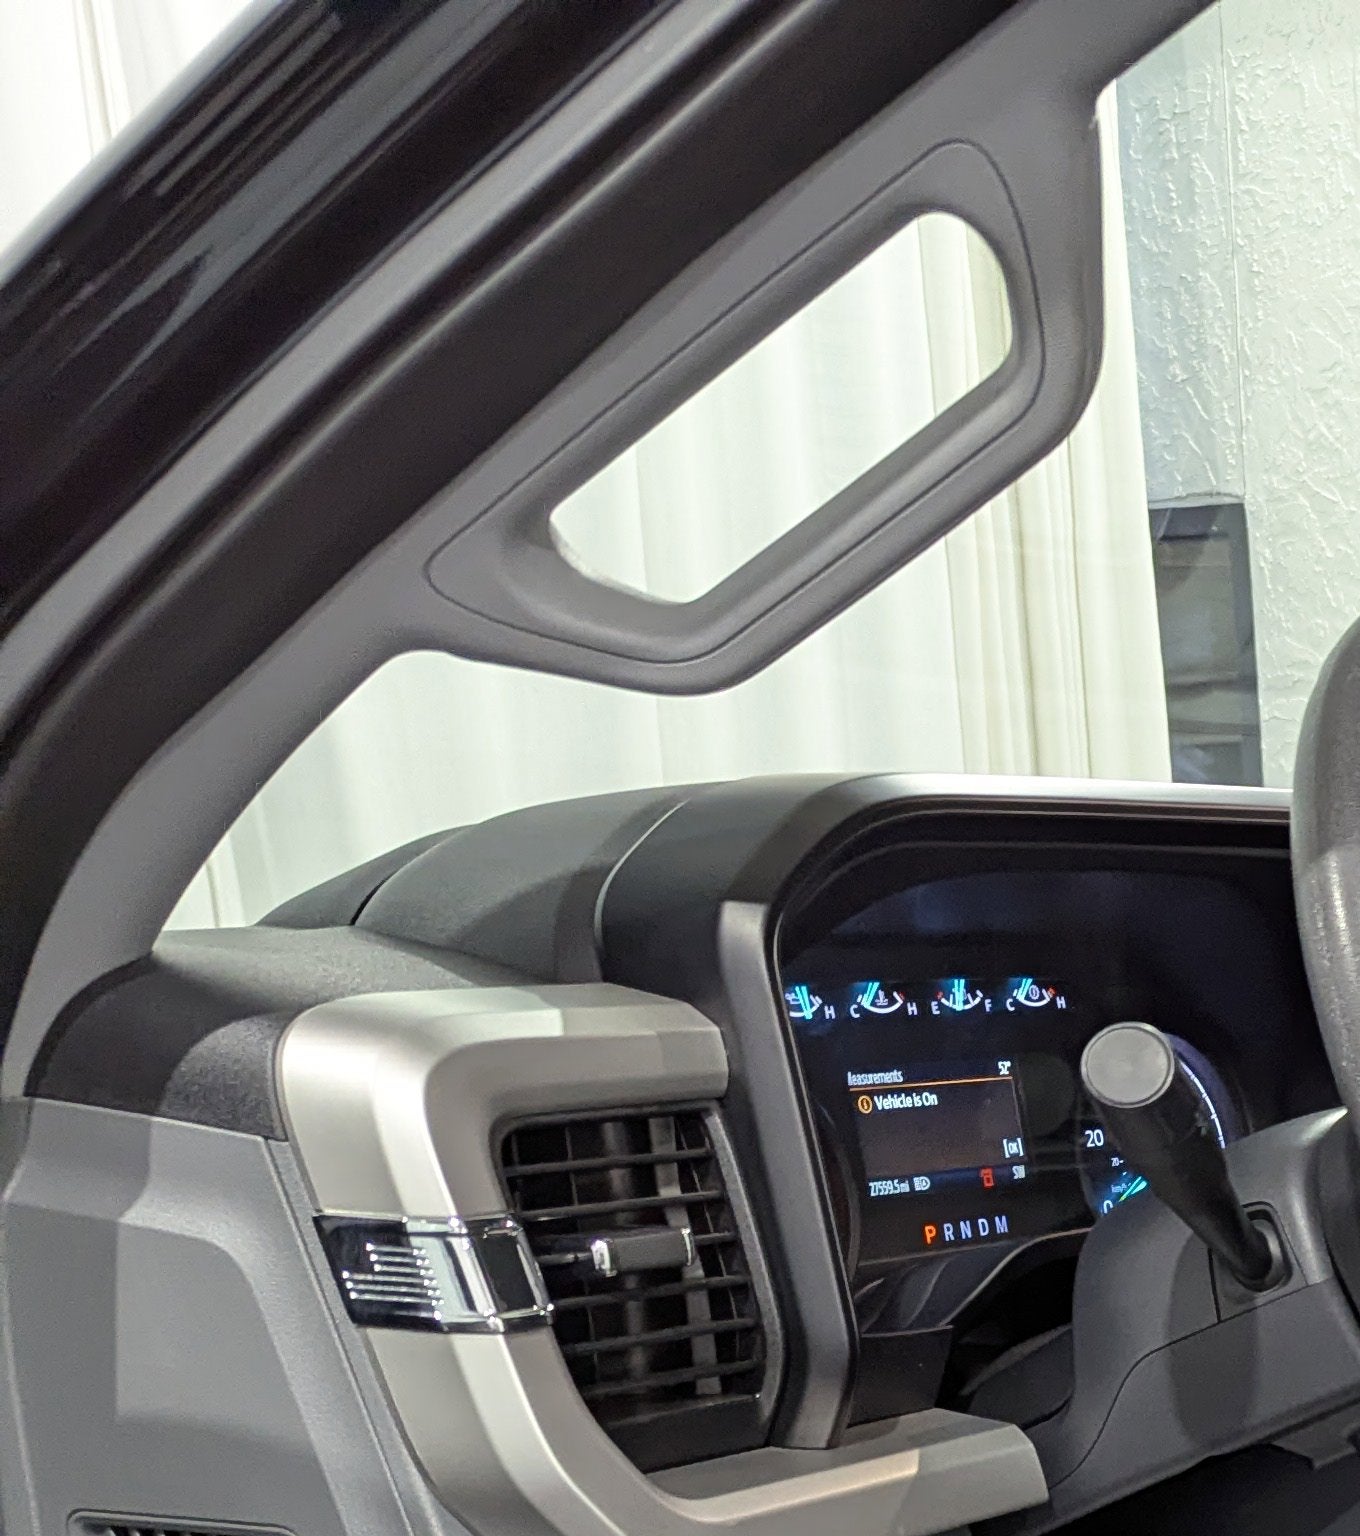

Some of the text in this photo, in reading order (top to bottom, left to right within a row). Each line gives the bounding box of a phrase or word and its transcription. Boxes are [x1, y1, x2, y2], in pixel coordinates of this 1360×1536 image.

[824, 1005, 836, 1019] H
[850, 1002, 918, 1018] C H
[932, 999, 993, 1015] E F
[1006, 996, 1067, 1012] C H
[873, 1093, 912, 1111] Vehicle
[922, 1091, 938, 1106] On
[1084, 1128, 1105, 1148] 20
[924, 1214, 1009, 1245] P R N D M
